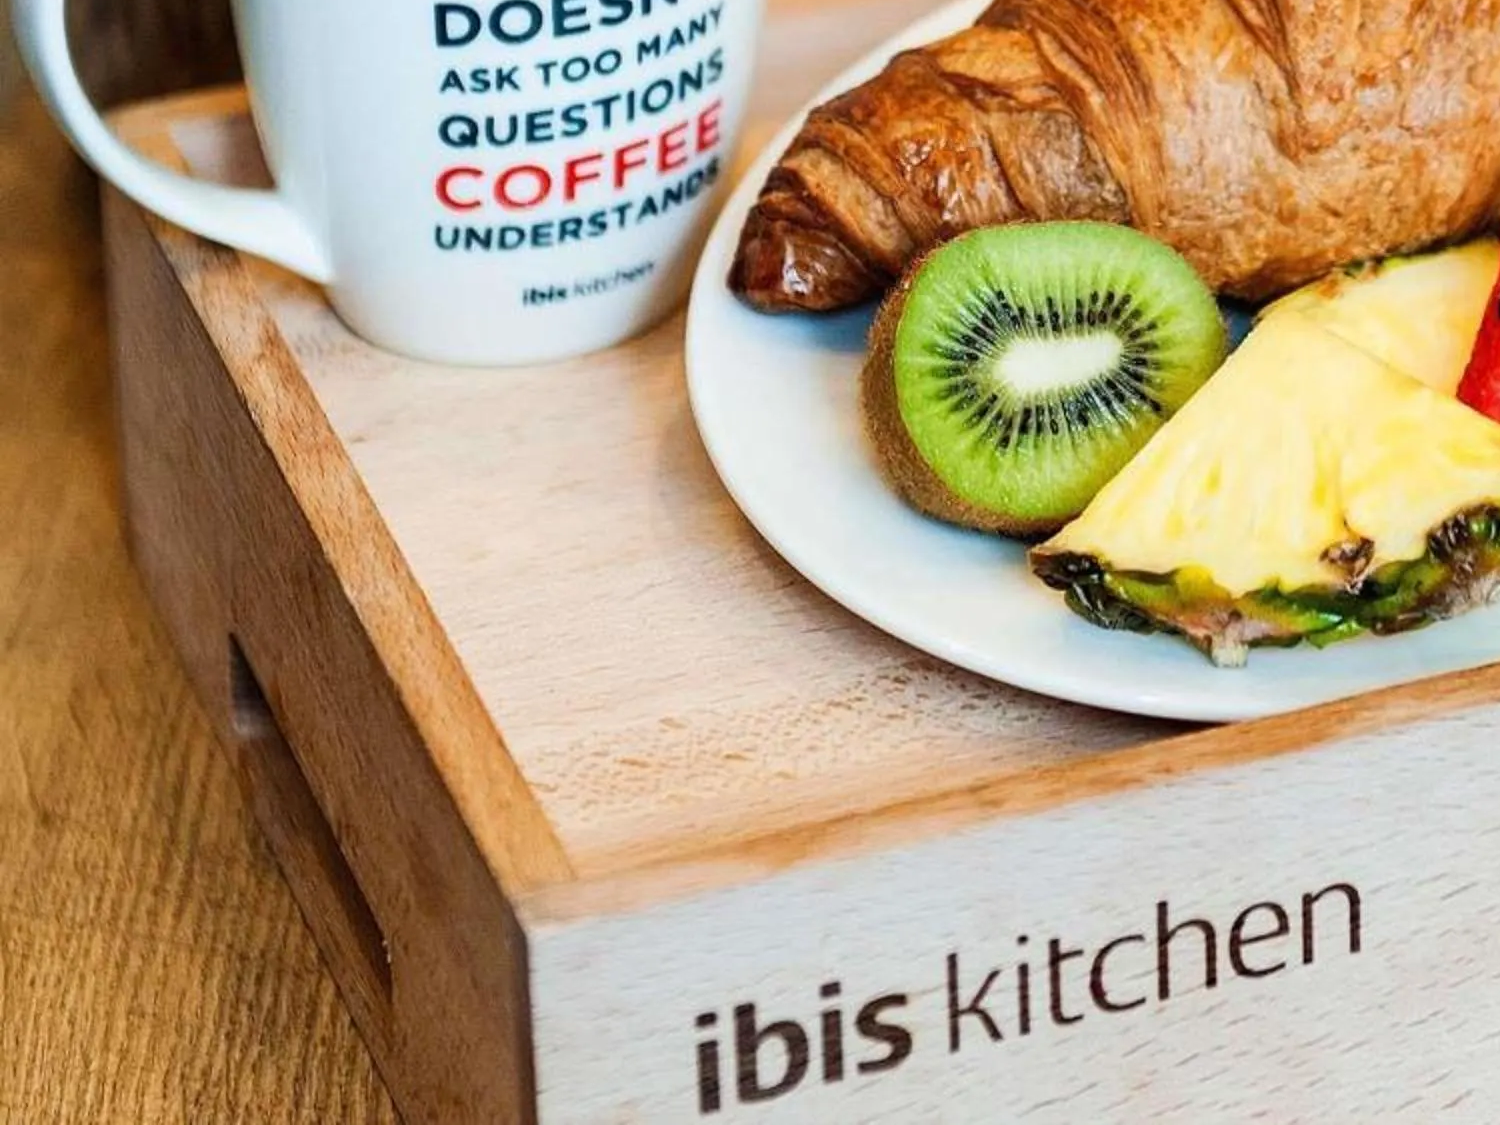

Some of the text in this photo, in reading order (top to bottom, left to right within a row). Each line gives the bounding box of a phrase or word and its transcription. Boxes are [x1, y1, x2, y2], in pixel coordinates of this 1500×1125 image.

[438, 48, 725, 148] QUESTIONS
[440, 2, 725, 94] ASK TOO MANY
[434, 99, 722, 213] COFFEE
[695, 881, 1361, 1115] ibis kitchen
